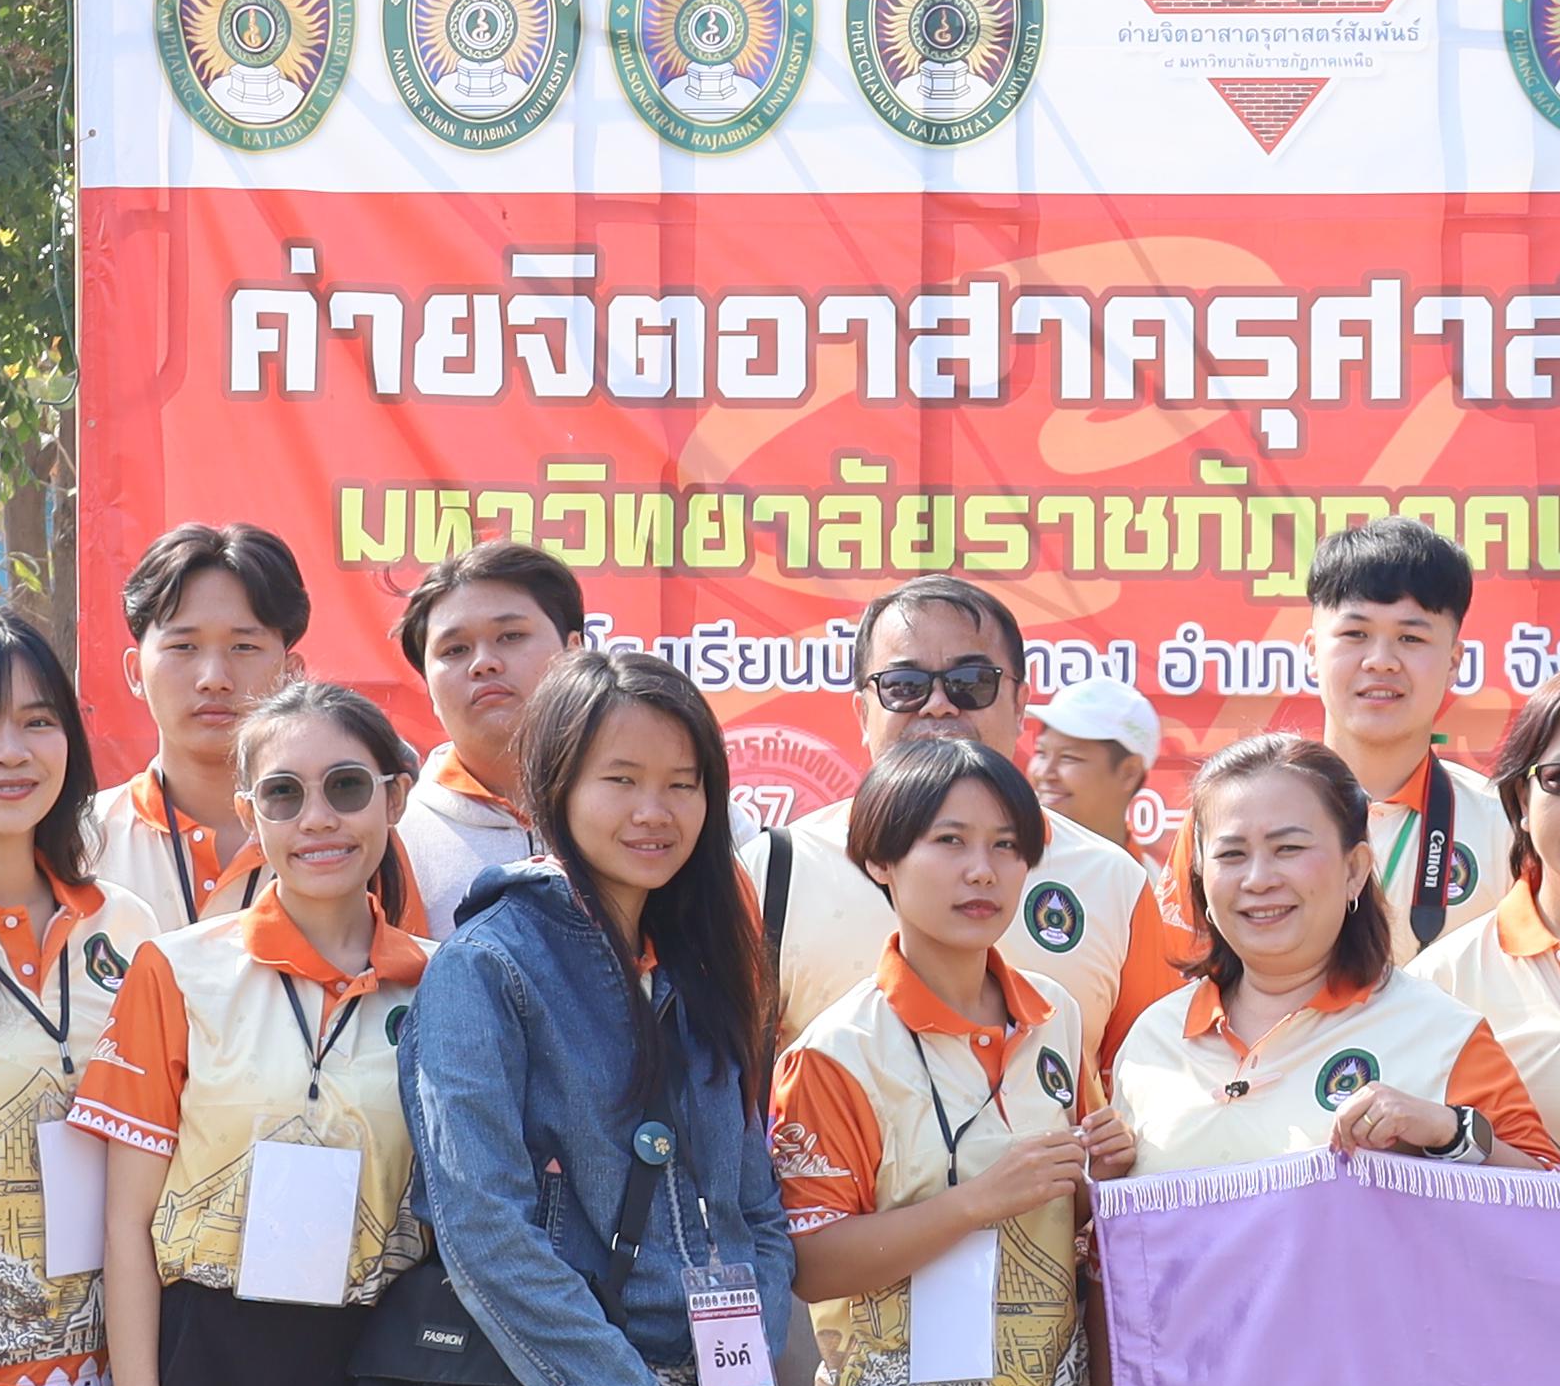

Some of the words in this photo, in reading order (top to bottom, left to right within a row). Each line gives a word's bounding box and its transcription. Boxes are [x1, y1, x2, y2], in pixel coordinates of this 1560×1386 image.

[198, 105, 235, 140] PHET
[242, 105, 324, 148] RAJABHAT
[319, 0, 351, 98] UNIVERSITY
[1117, 17, 1422, 50] ค่ายจิตอาสาครุศาสตร์สัมพันธ์
[1179, 51, 1375, 71] มหาวิทยาลัยราชภัฏภาคเหนือ
[1512, 28, 1538, 89] CHIANG
[1534, 90, 1560, 118] MAI
[392, 48, 422, 108] NAKHON
[420, 105, 457, 138] SAWAN
[463, 120, 518, 146] RAJABHAT
[523, 49, 569, 125] UNIVERSITY
[616, 29, 687, 141] PIBULSONGKRAM
[691, 116, 764, 151] RAJABHAT
[763, 29, 806, 117] UNIVERSITY
[851, 20, 902, 122] PHETCHABUN
[907, 111, 995, 142] RAJABHAT
[996, 21, 1041, 111] UNIVERSITY
[1424, 829, 1446, 888] Canon
[422, 1330, 464, 1346] FASHION
